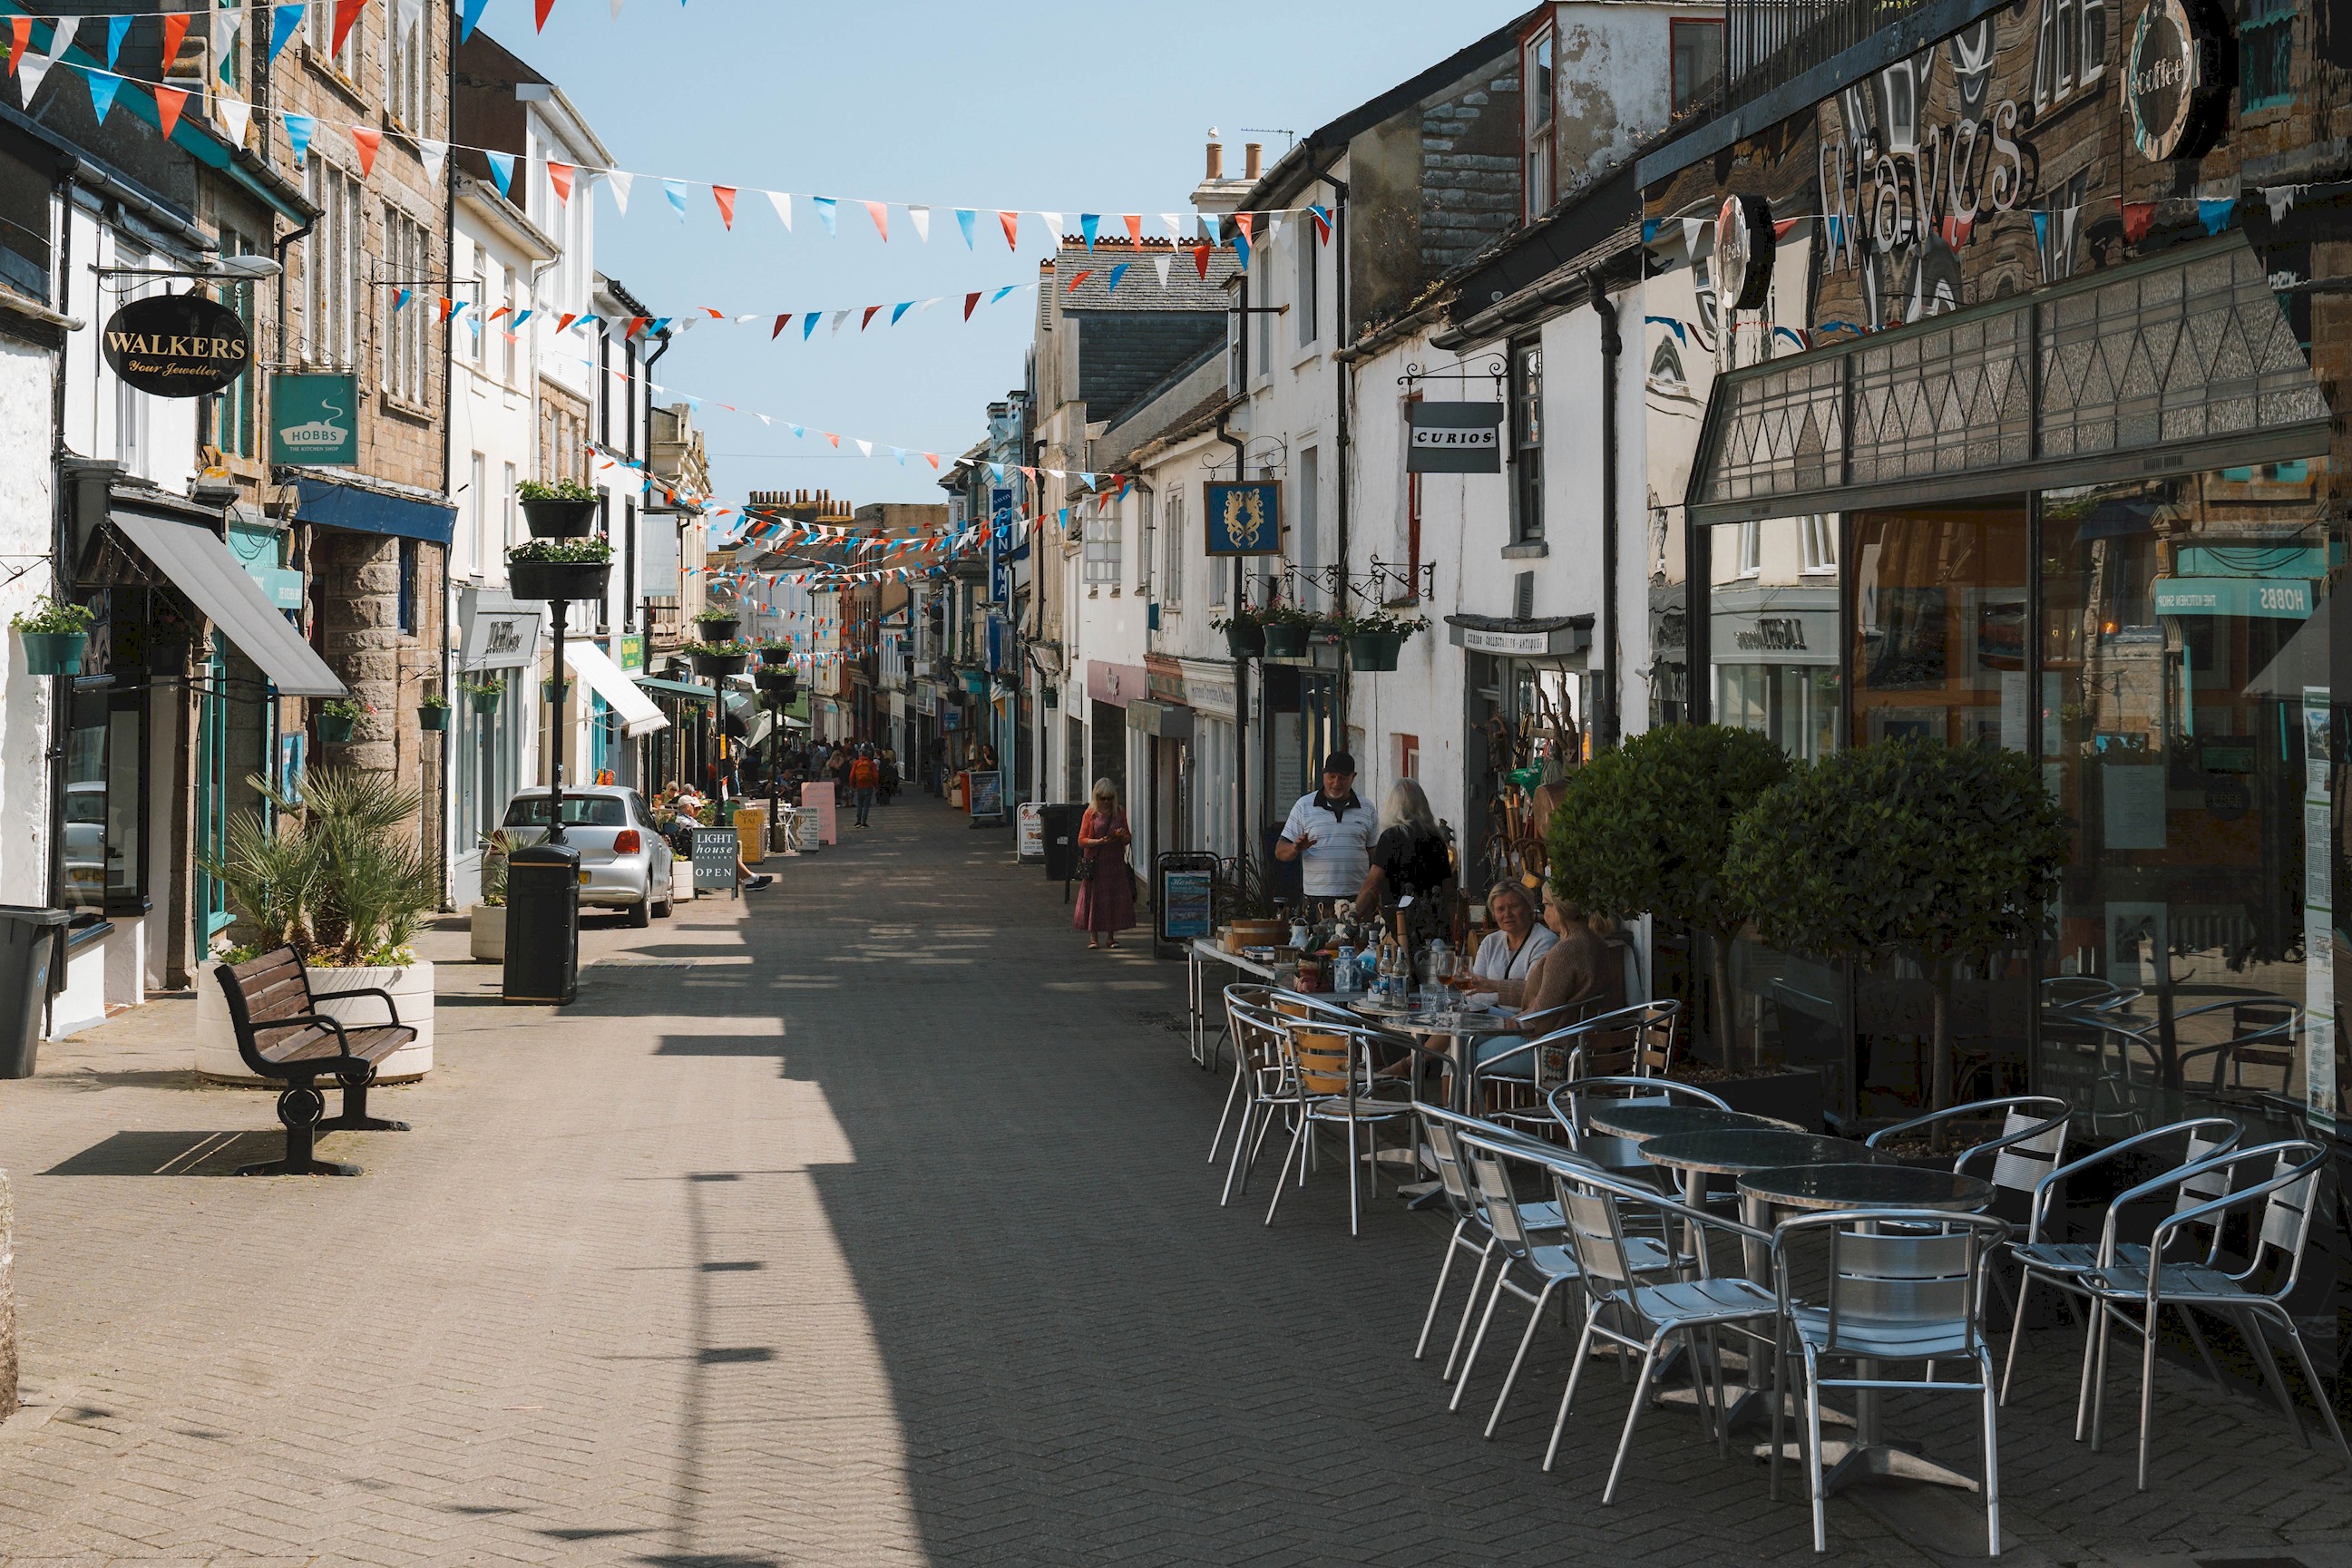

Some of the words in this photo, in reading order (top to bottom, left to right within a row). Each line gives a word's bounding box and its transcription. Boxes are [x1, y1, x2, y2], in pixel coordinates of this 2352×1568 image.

[2137, 57, 2183, 95] coffee
[1819, 100, 2022, 277] Waves
[1723, 241, 1741, 260] teas
[106, 331, 246, 360] WALKERS
[129, 359, 162, 373] Your
[162, 362, 220, 377] Jeweller
[292, 430, 337, 442] HOBBS
[1417, 432, 1492, 443] CURIOS
[992, 492, 1011, 505] SAVOY
[998, 507, 1009, 596] CNMA
[1468, 633, 1482, 645] CURIOS
[1519, 638, 1543, 651] ANTIQUES
[697, 833, 734, 843] LIGHT
[696, 843, 733, 853] house
[695, 868, 732, 877] OPEN
